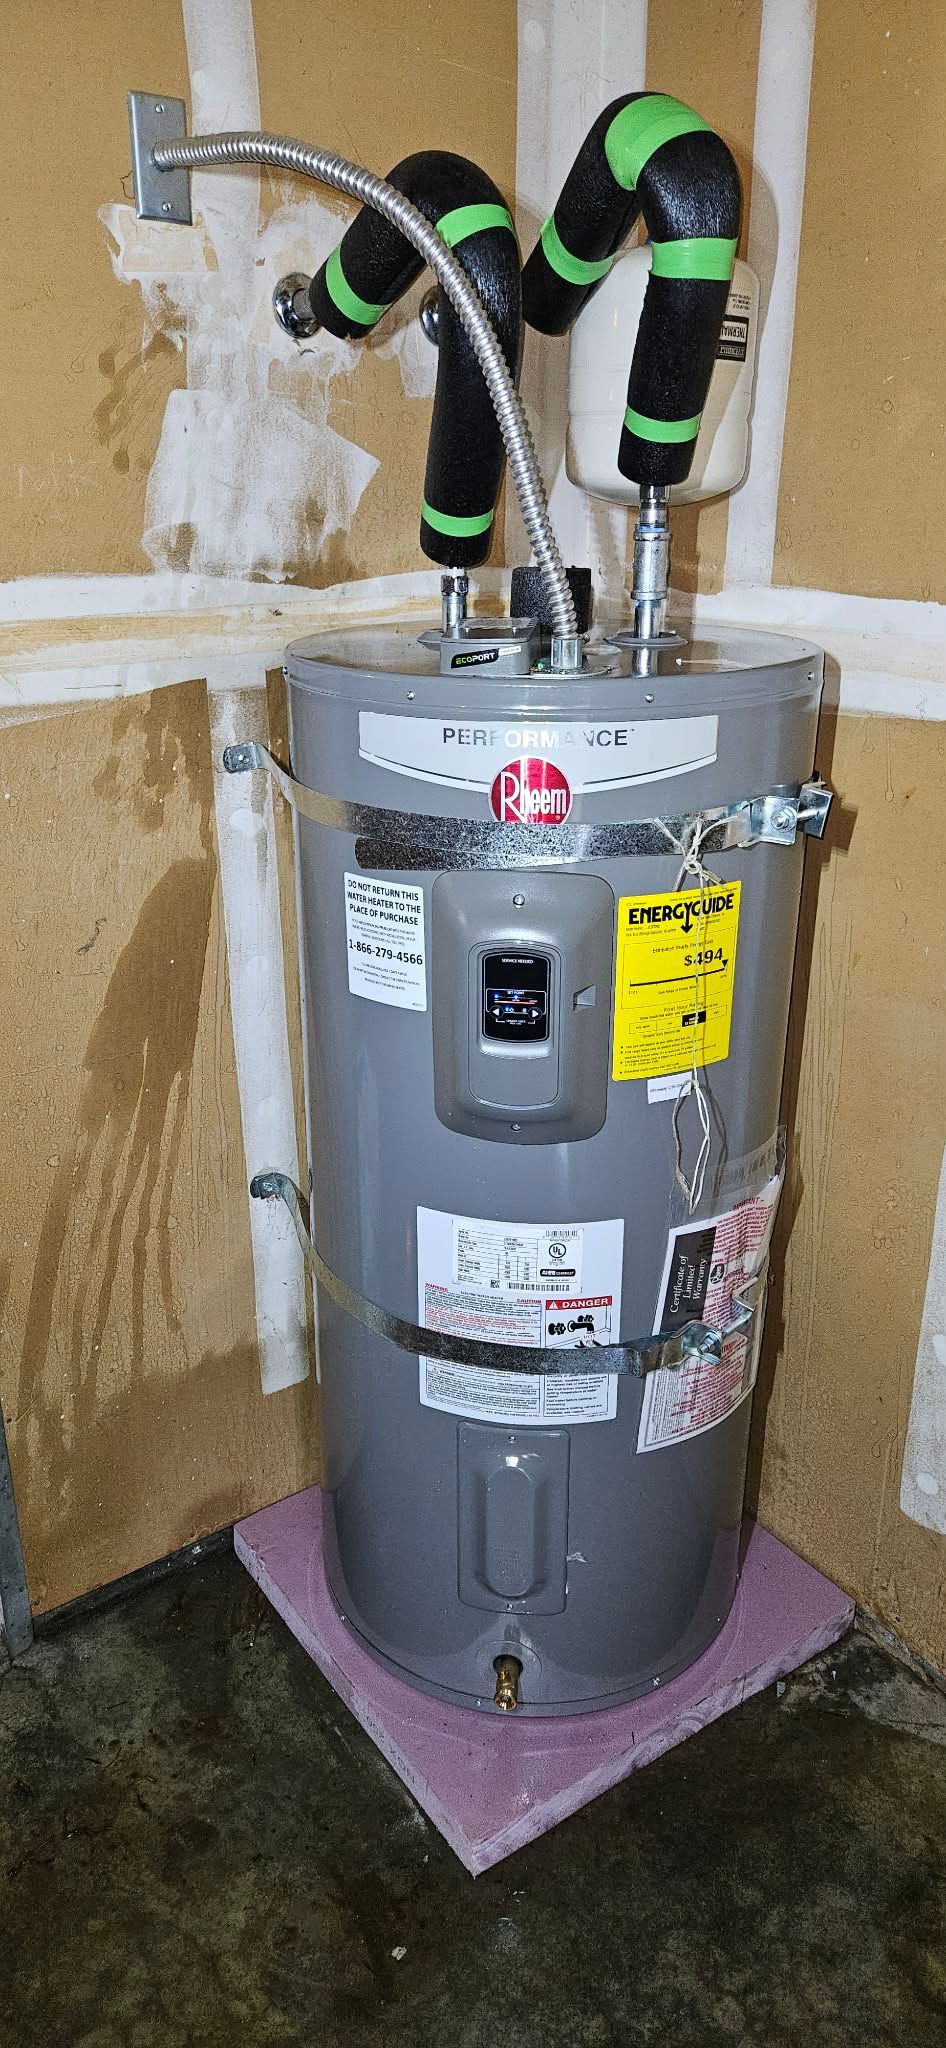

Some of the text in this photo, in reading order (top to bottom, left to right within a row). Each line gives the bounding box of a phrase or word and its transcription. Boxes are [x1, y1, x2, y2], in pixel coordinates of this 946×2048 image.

[456, 652, 495, 665] ECOPORT
[500, 757, 567, 822] Rheem
[348, 879, 419, 901] DO NOT RETURN THIS
[347, 891, 421, 914] WATER HEATER TO THE
[349, 903, 419, 926] PLACE OF PURCHASE
[349, 939, 423, 965] 1-866-279-4566
[684, 948, 723, 967] $494
[553, 1246, 562, 1255] UL
[425, 1282, 449, 1292] WARNING
[670, 1254, 689, 1313] Certificate of
[682, 1264, 697, 1299] Limited
[692, 1258, 708, 1300] Warranty
[562, 1298, 609, 1309] DANGER
